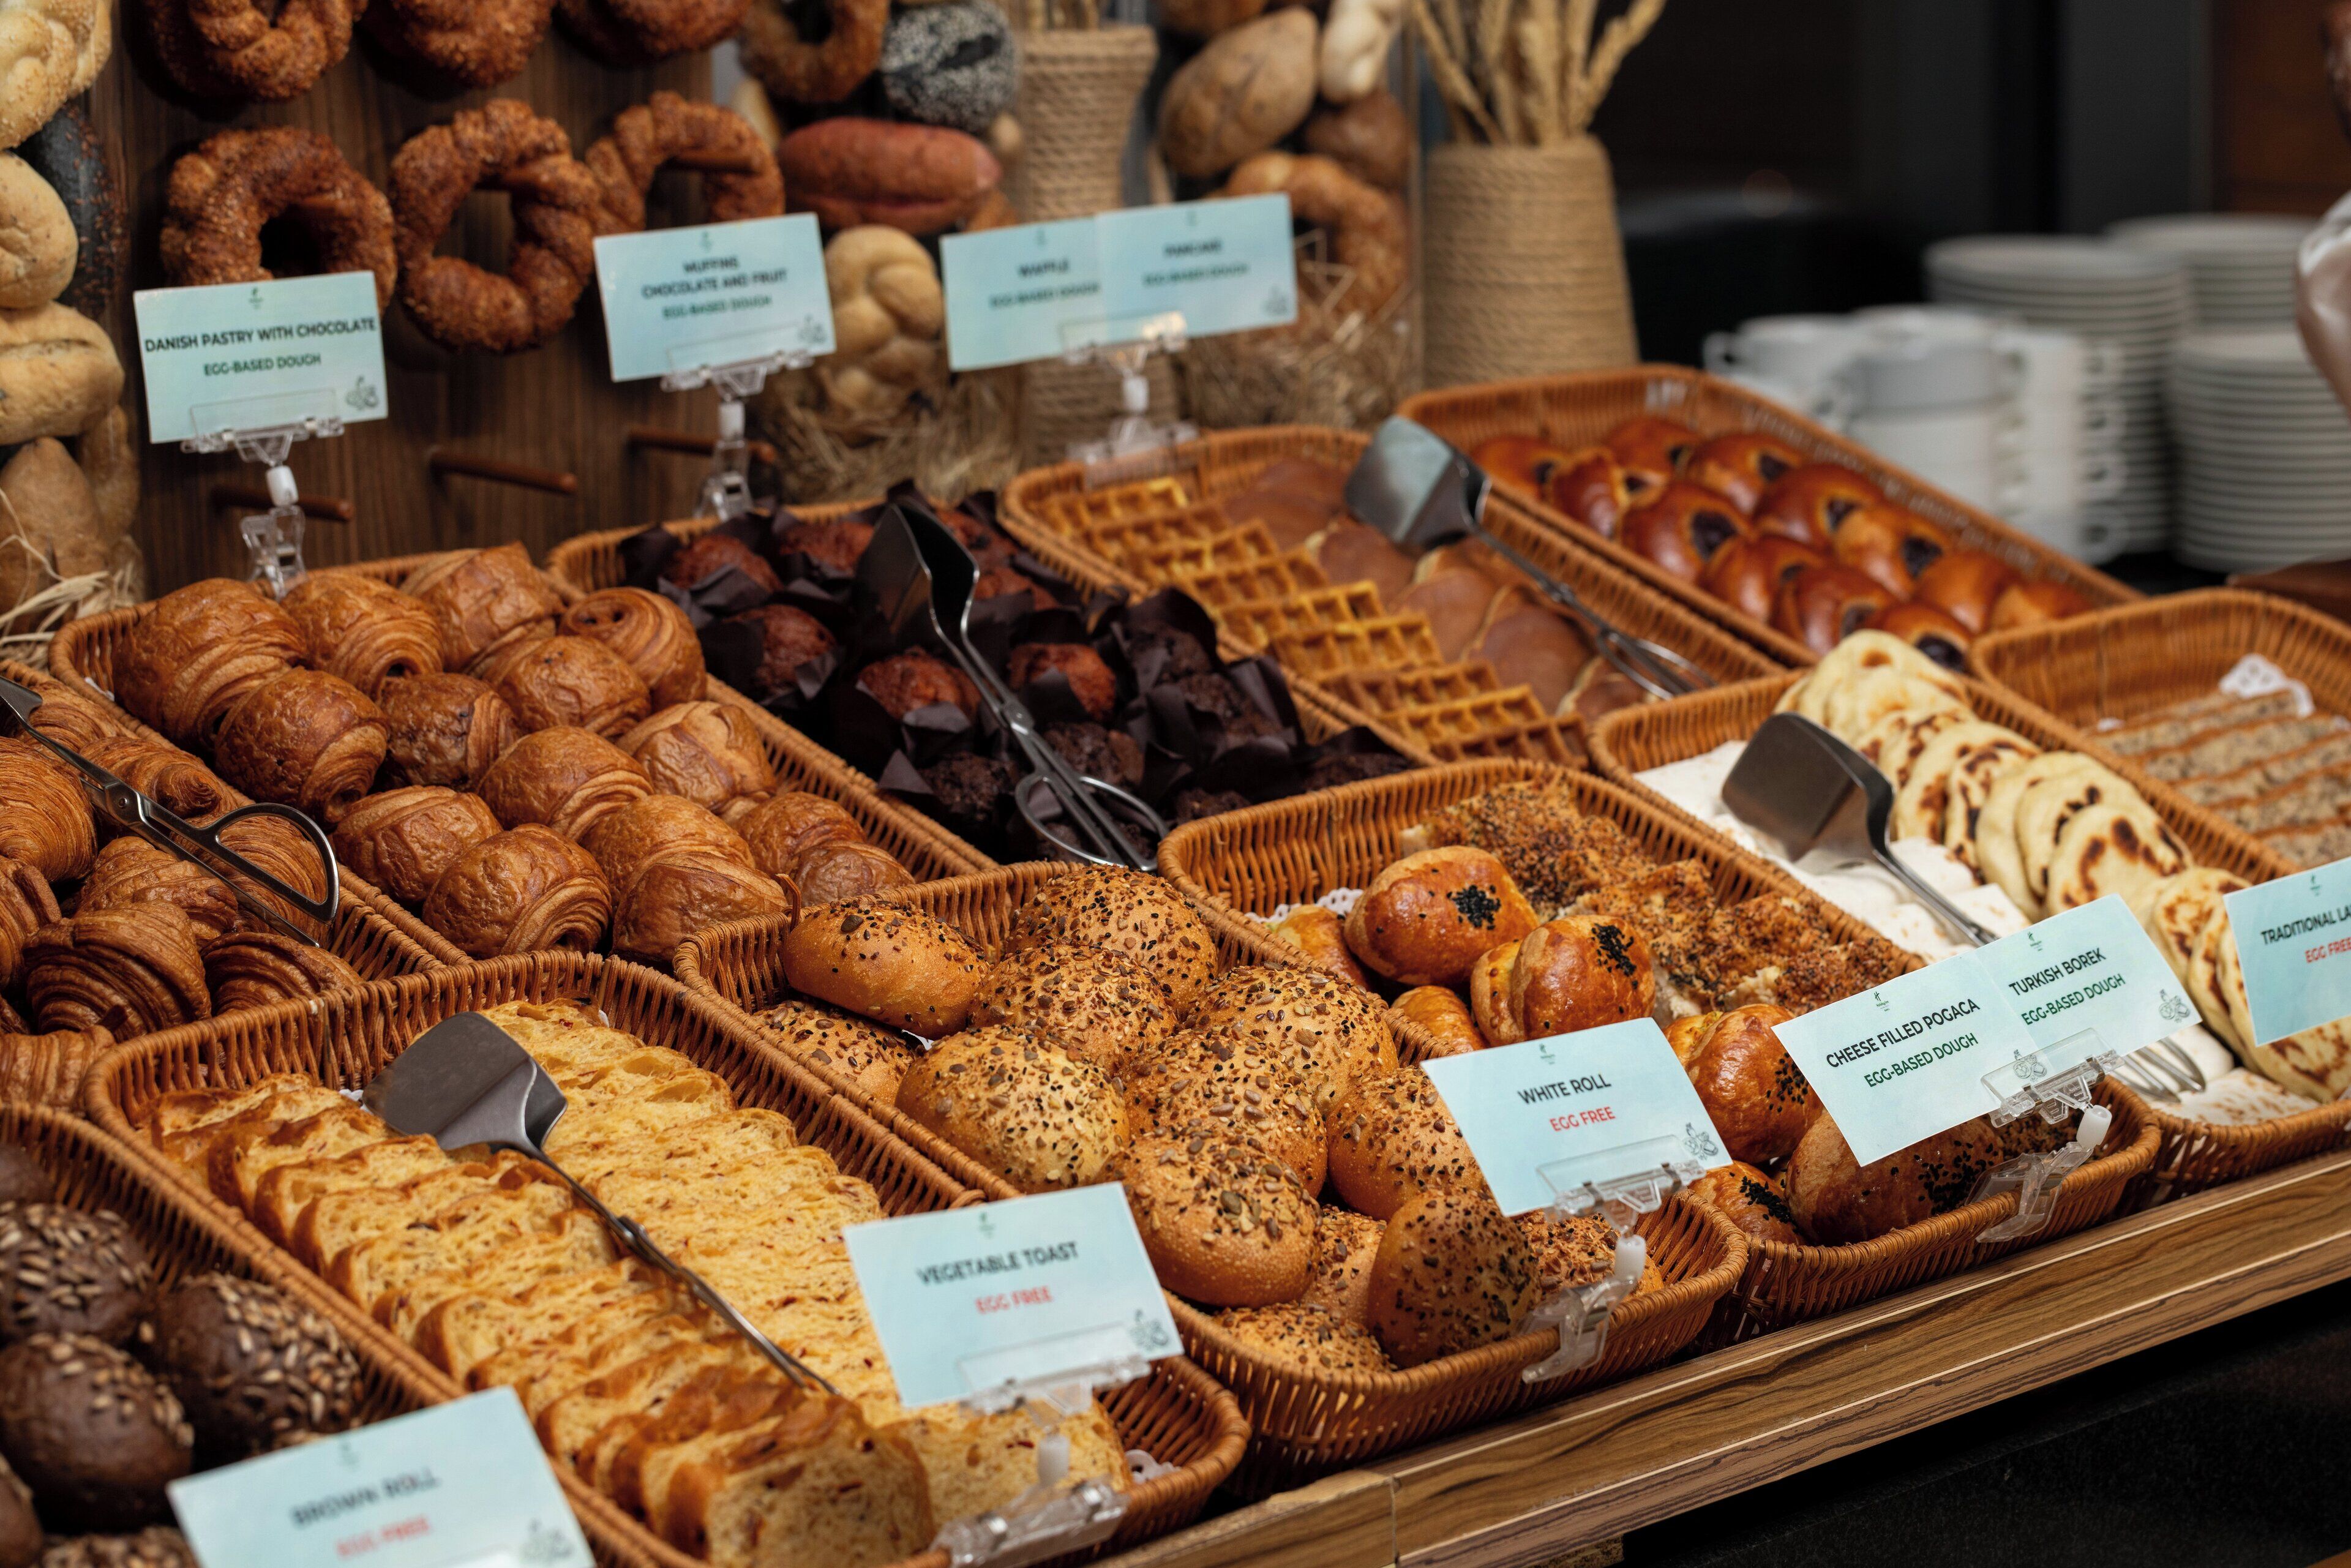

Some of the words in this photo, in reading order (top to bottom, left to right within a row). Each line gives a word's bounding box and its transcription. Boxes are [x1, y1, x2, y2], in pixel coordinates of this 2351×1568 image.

[642, 278, 718, 298] CHOCOLATE
[723, 276, 748, 287] AND
[752, 271, 786, 283] FRUIT
[663, 301, 727, 319] EGG-BASED
[730, 296, 771, 311] DOUGH
[145, 336, 198, 352] DANISH
[202, 331, 253, 346] PASTRY
[258, 327, 293, 340] WITH
[296, 318, 375, 337] CHOCOLATE
[204, 358, 274, 376] EGG-BASED
[277, 354, 321, 369] DOUGH
[2261, 912, 2336, 944] TRADITIONAL
[2336, 904, 2351, 922] LA
[2305, 946, 2327, 963] EGG
[2328, 937, 2351, 954] FREE
[2009, 966, 2063, 995] TURKISH
[2062, 948, 2105, 974] BOREK
[2021, 992, 2084, 1025] EGG-BASED
[2083, 974, 2125, 999] DOUGH
[1826, 1038, 1879, 1067] CHEESE
[1877, 1021, 1923, 1047] FILLED
[1923, 999, 1980, 1029] POGACA
[1864, 1052, 1932, 1087] EGG-BASED
[1932, 1033, 1978, 1059] DOUGH
[1518, 1082, 1570, 1104] WHITE
[1570, 1075, 1611, 1093] ROLL
[1550, 1114, 1579, 1131] EGG
[1580, 1107, 1615, 1124] FREE
[918, 1253, 1019, 1283] VEGETABLE
[1024, 1242, 1077, 1264] TOAST
[975, 1295, 1010, 1314] EGG
[1013, 1287, 1051, 1304] FREE
[293, 1490, 377, 1525] BROWN
[384, 1472, 439, 1498] ROLL
